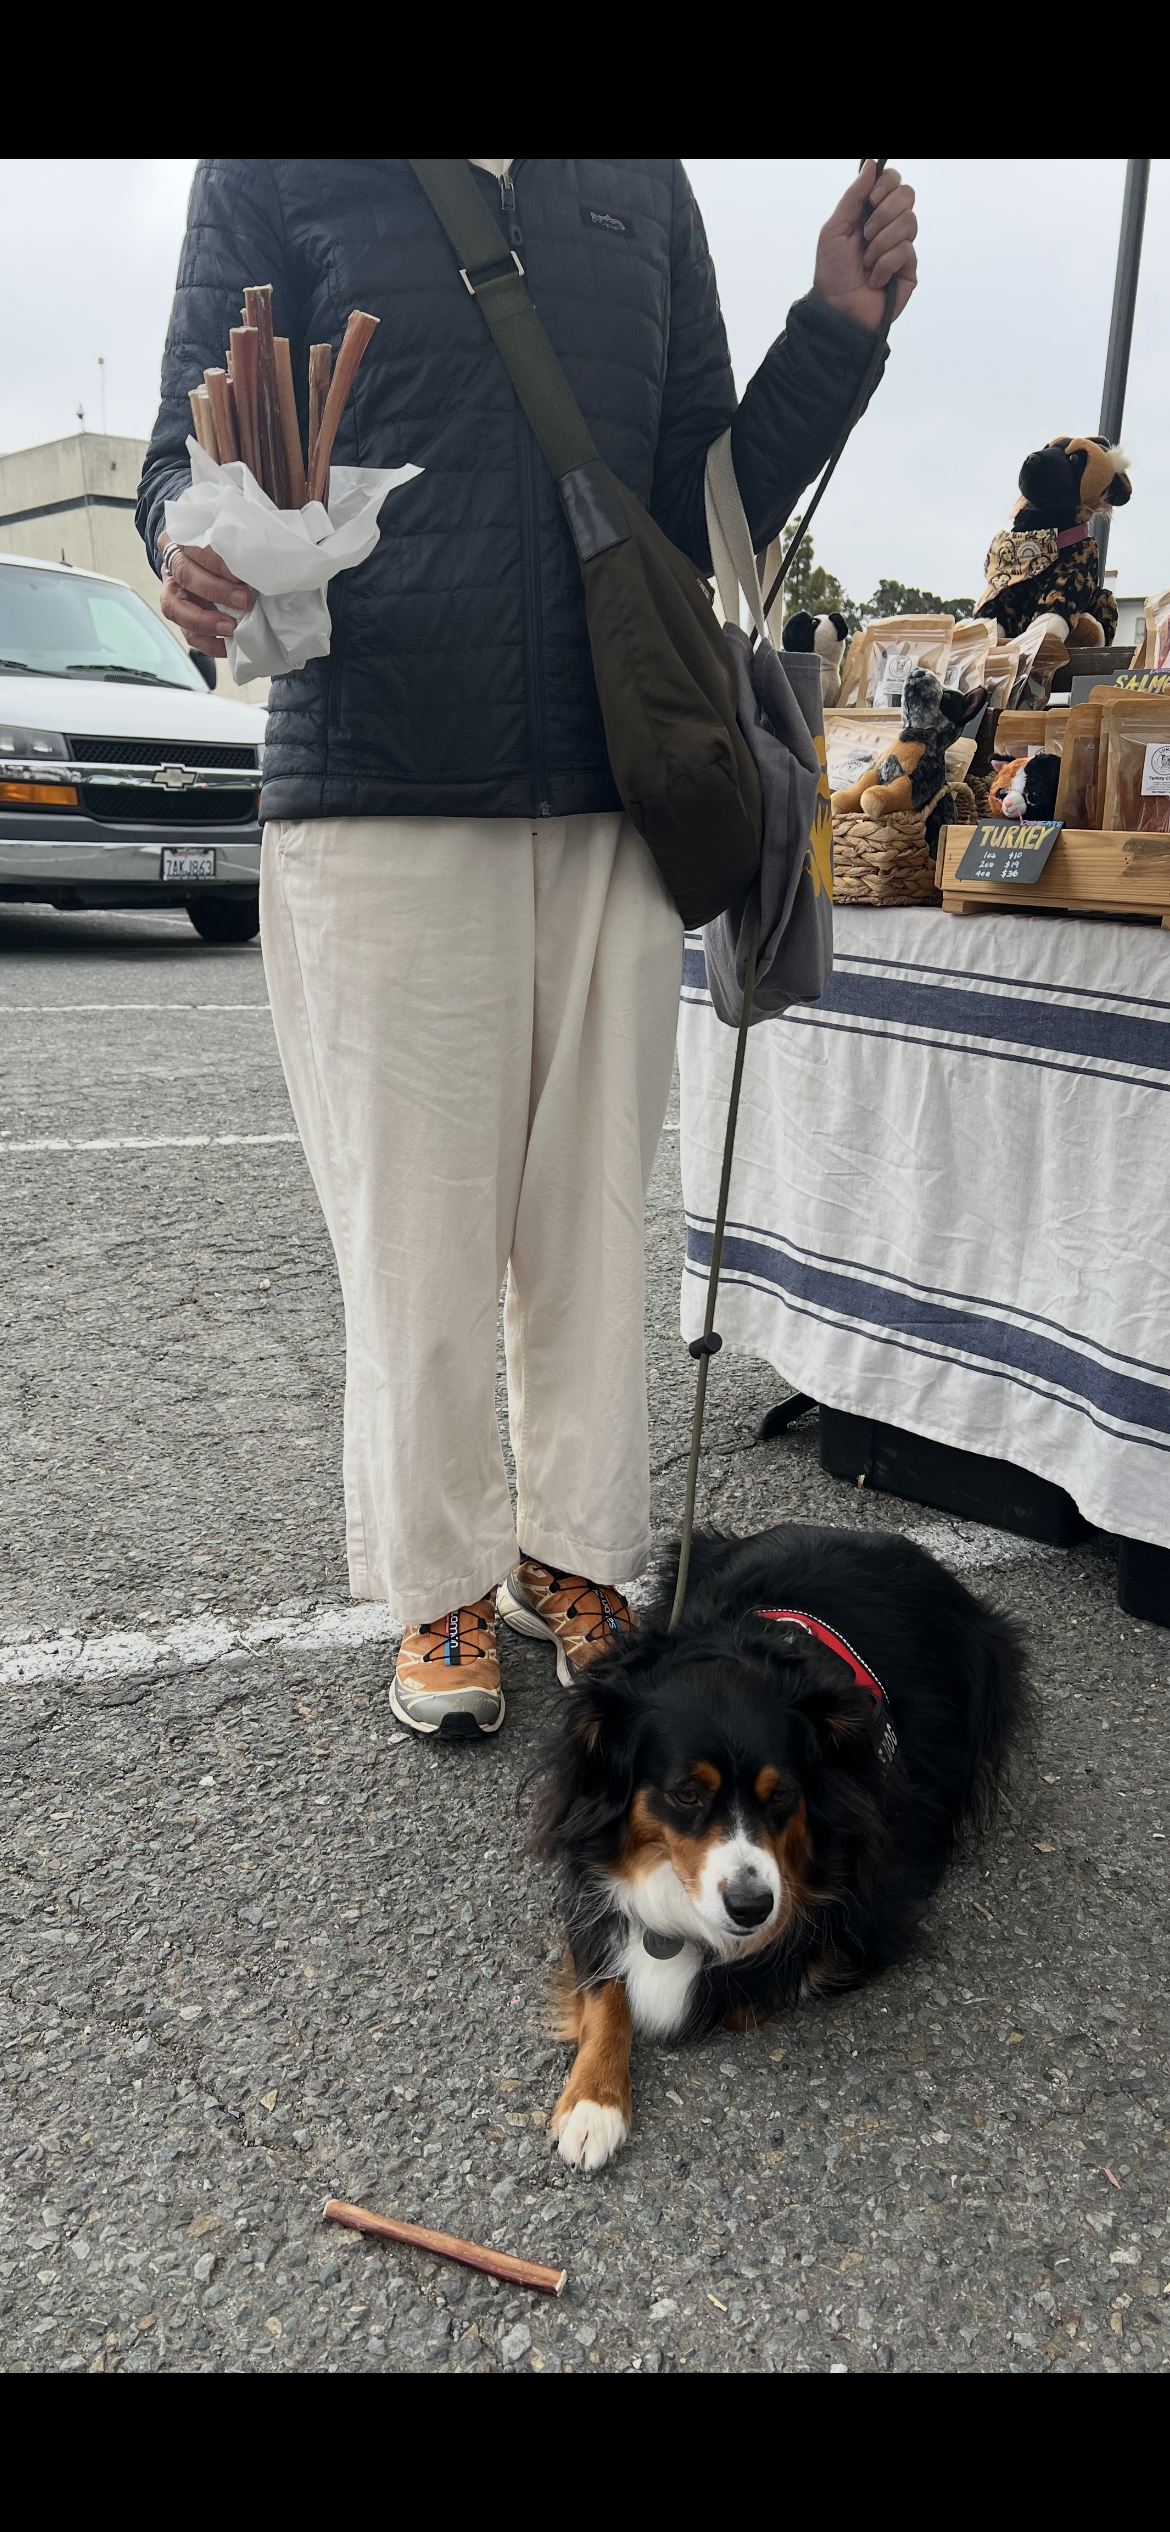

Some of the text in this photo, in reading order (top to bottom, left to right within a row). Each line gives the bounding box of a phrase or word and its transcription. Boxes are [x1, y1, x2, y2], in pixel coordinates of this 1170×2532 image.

[980, 825, 1055, 851] TURKEY
[1008, 851, 1023, 859] $10
[166, 860, 213, 877] 7AKJ863
[1003, 860, 1020, 869] $19
[1000, 868, 1019, 879] $36
